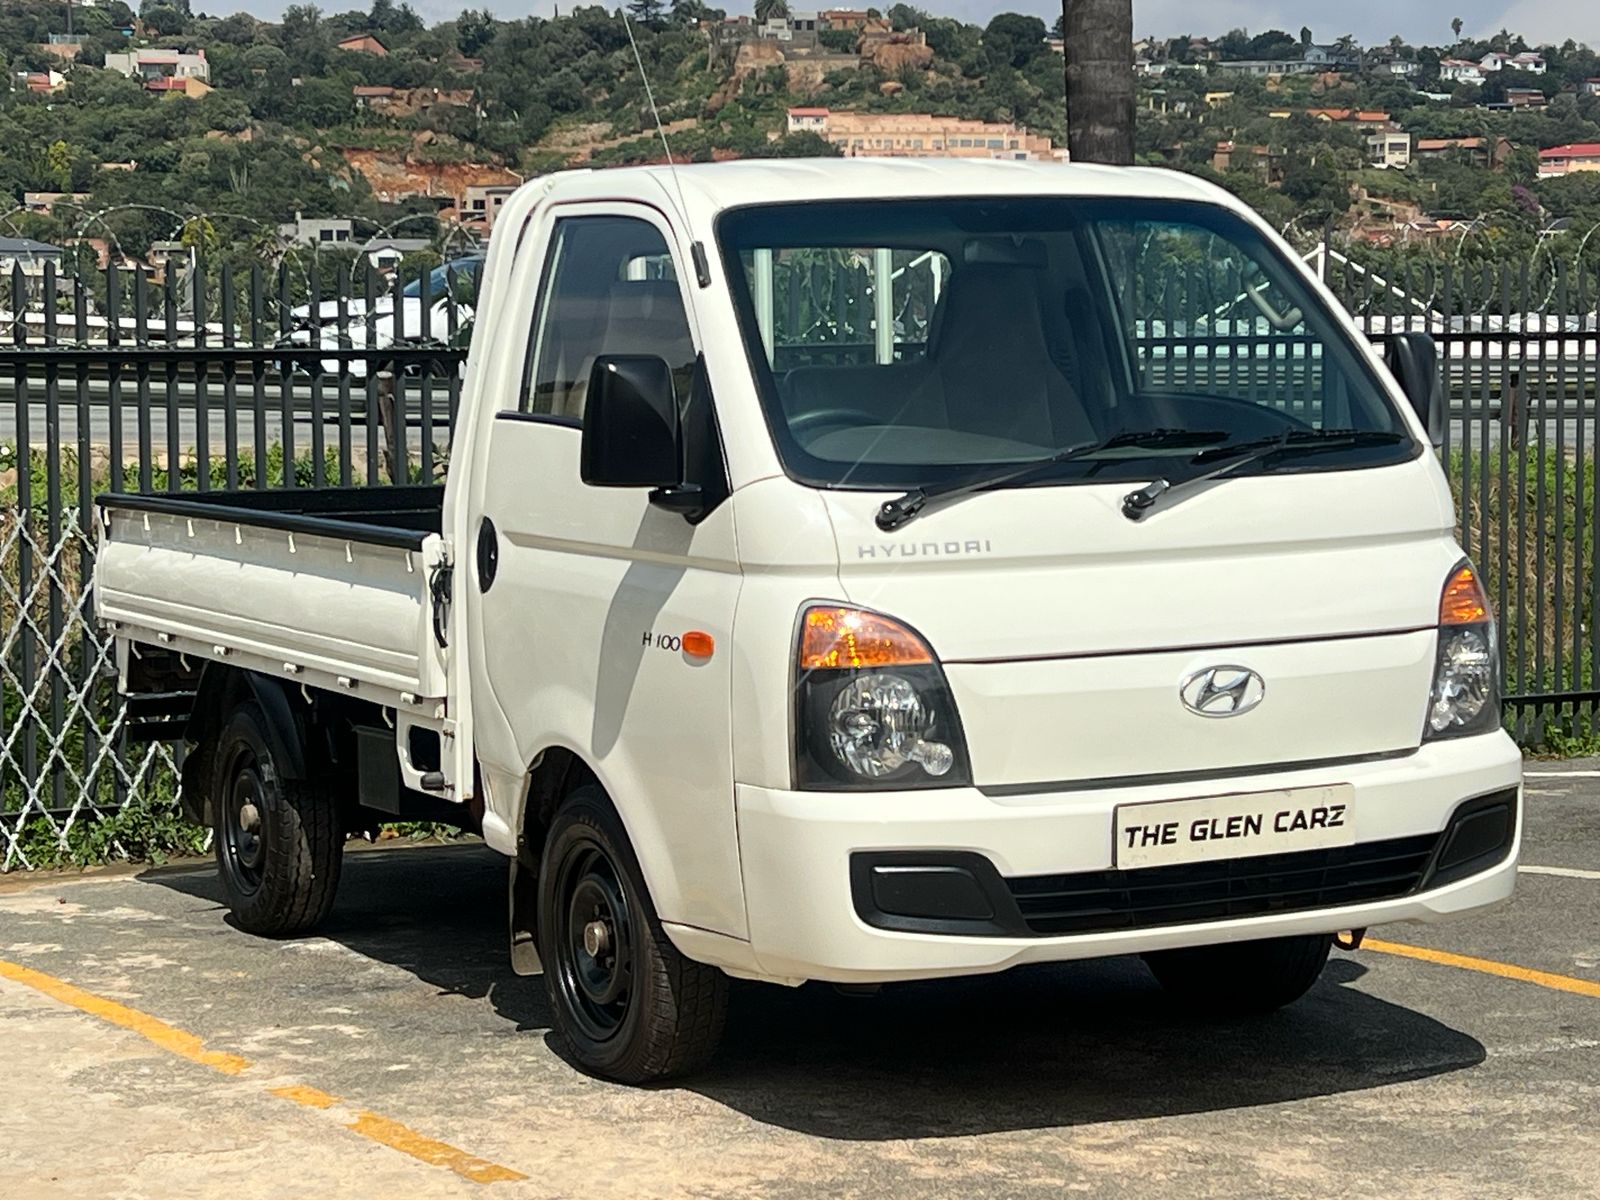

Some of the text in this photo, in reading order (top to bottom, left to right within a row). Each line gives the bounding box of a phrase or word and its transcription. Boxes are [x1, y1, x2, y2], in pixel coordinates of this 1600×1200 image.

[858, 540, 991, 558] HYUNDAI
[1125, 804, 1346, 848] THE GLEN CARZ
